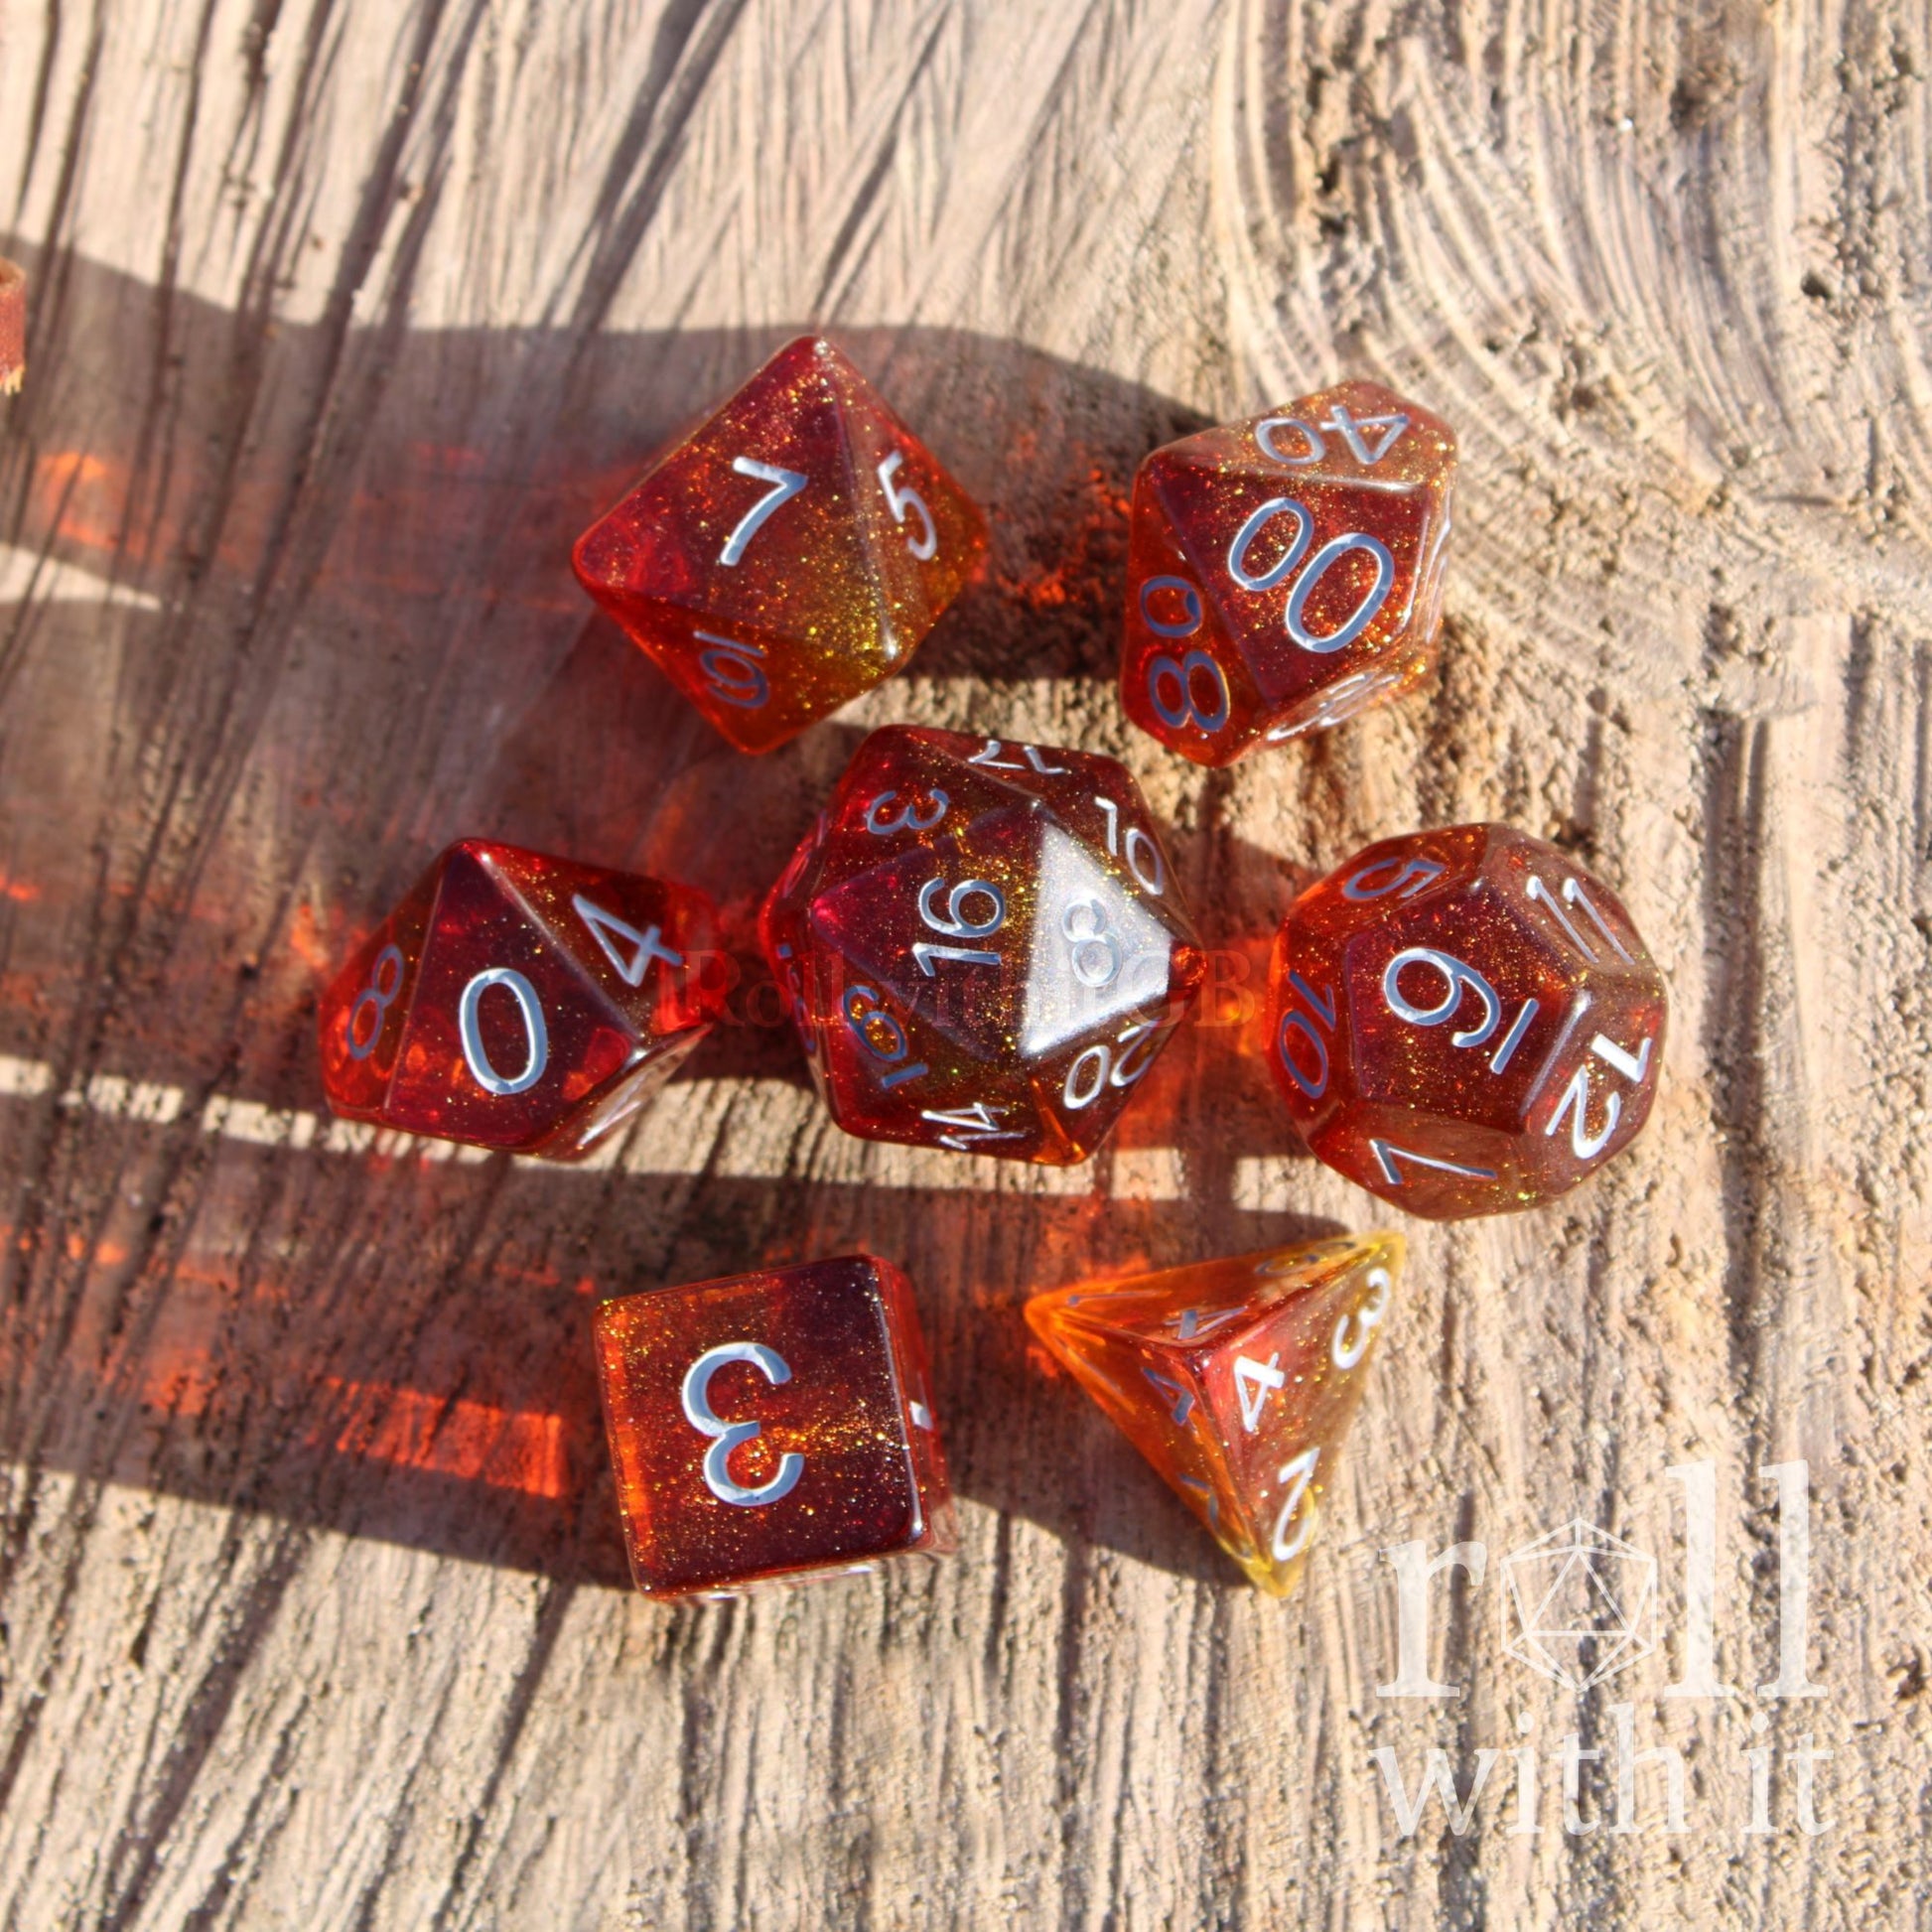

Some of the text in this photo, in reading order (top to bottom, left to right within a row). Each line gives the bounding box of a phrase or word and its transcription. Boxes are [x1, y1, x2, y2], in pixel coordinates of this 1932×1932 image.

[1255, 404, 1411, 465] 40
[721, 456, 809, 567] 7
[878, 451, 937, 561] 5
[1227, 496, 1396, 654] 00
[1139, 575, 1231, 733] 80
[865, 788, 949, 836] 3
[1094, 795, 1164, 896] 10
[910, 877, 1007, 977] 16
[1341, 857, 1446, 899] 5
[1526, 875, 1636, 967] 11
[572, 893, 684, 988] 4
[1062, 897, 1122, 988] 8
[346, 944, 403, 1059] 8
[459, 967, 548, 1095] 0
[1279, 969, 1336, 1099] 10
[1063, 1017, 1162, 1109] 20
[1545, 1034, 1652, 1160] 12
[920, 1101, 1025, 1150] 14
[1332, 1267, 1390, 1369] 3
[681, 1341, 804, 1507] 3
[1234, 1352, 1285, 1433] 4
[1274, 1447, 1320, 1562] 2
